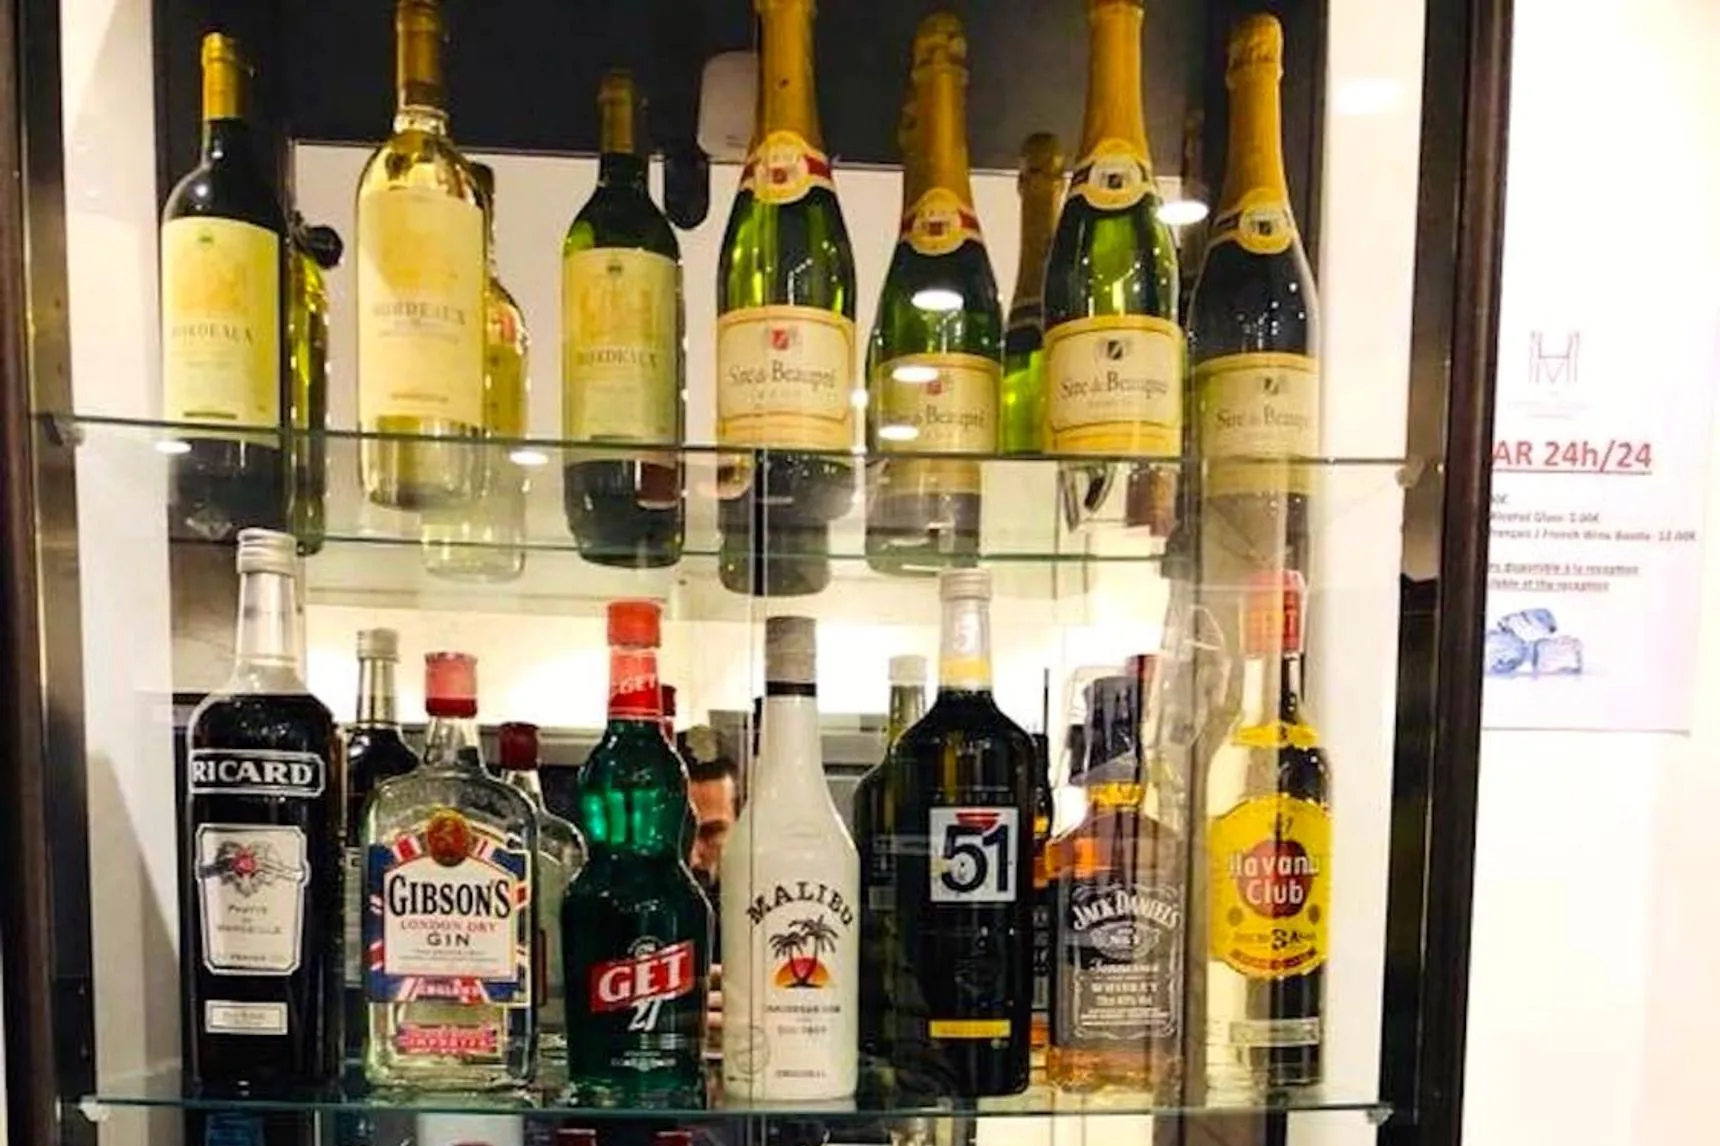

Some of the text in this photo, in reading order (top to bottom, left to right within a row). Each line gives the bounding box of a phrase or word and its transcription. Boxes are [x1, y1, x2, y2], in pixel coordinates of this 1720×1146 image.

[1544, 439, 1652, 473] 24h/24
[192, 759, 314, 786] RICARD
[941, 824, 1009, 893] 51
[746, 881, 855, 927] MALIBU
[1246, 880, 1304, 906] Club
[401, 918, 498, 933] LONDON DRY
[426, 932, 471, 948] GIN
[598, 949, 689, 1004] GET
